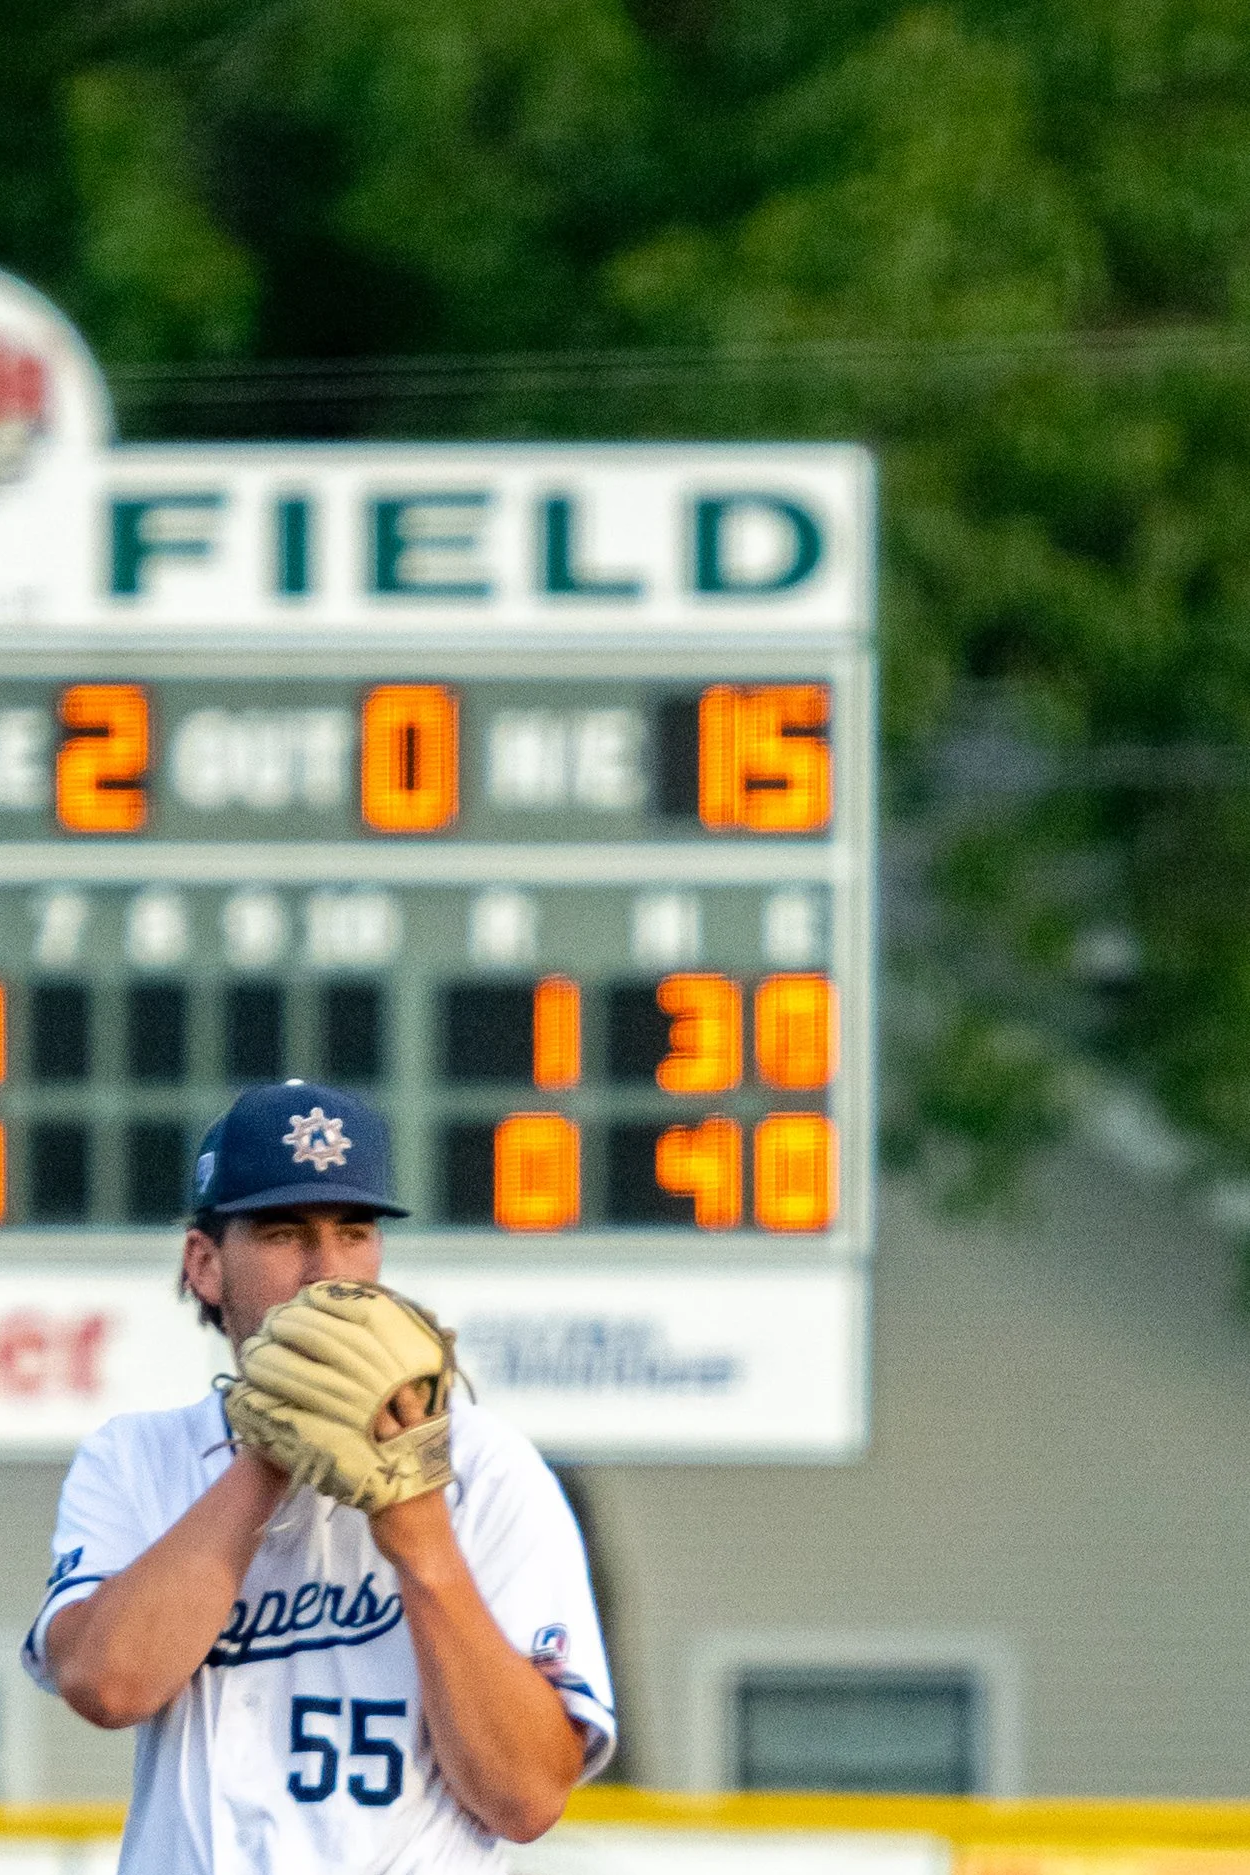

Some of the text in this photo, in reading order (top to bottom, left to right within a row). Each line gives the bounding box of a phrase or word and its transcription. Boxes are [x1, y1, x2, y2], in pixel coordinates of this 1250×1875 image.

[108, 488, 828, 598] FIELD
[55, 683, 150, 834] 2
[172, 708, 350, 812] OUT
[360, 683, 460, 834] 0
[697, 684, 834, 834] 15
[533, 974, 581, 1090] 1
[287, 1694, 408, 1807] 55
